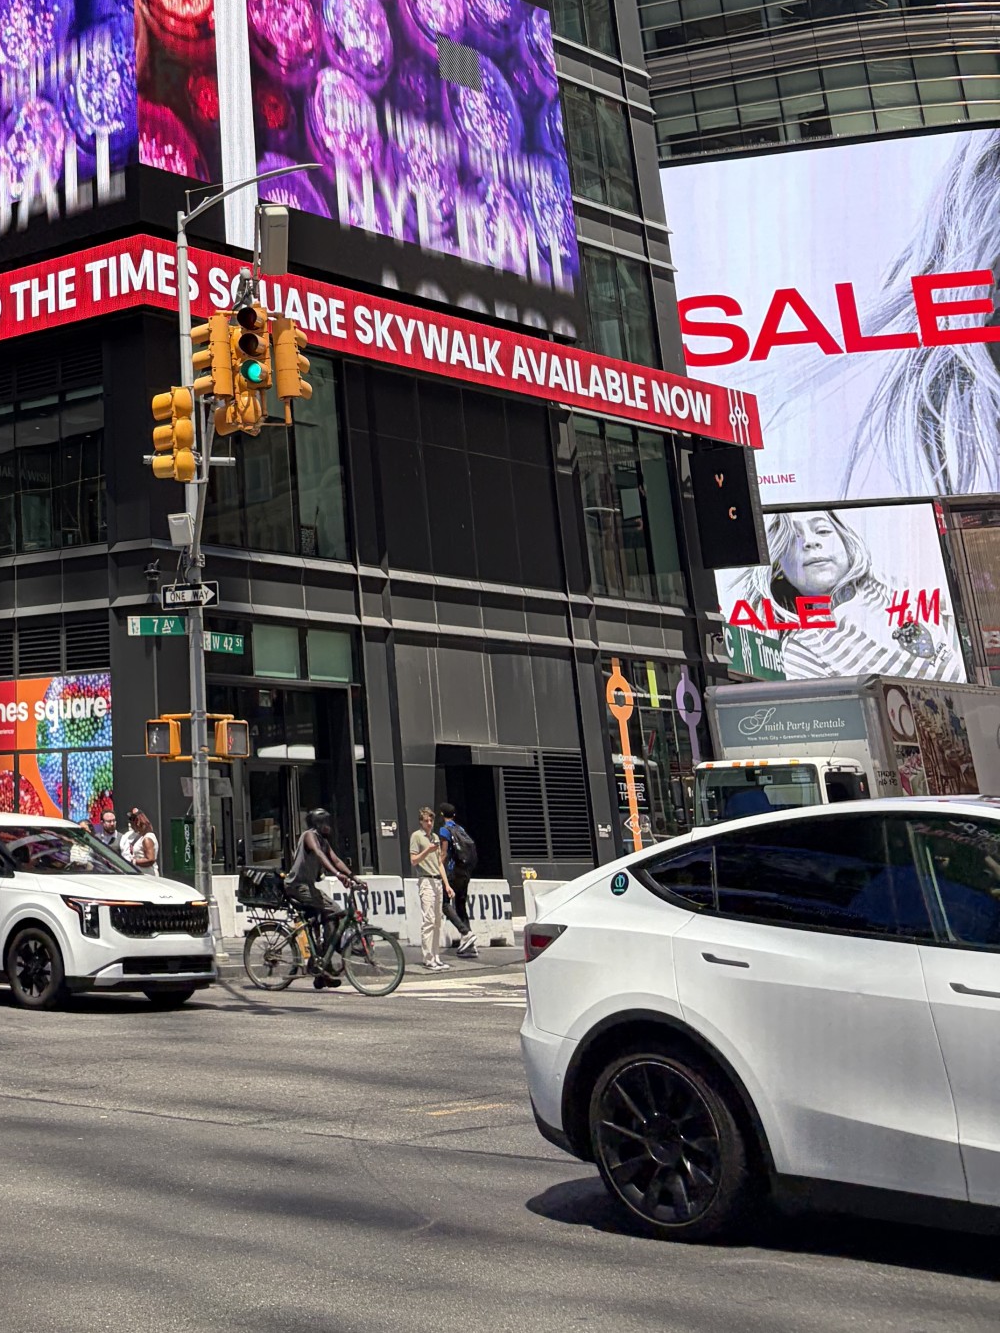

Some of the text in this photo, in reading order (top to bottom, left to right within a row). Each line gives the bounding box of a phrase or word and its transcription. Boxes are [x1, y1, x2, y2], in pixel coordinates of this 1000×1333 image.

[677, 269, 1000, 367] SALE
[9, 266, 78, 322] THE
[84, 248, 200, 303] TIMES
[354, 304, 506, 377] SKYWALK
[511, 344, 649, 412] AVAILABLE
[651, 378, 712, 426] NOW
[714, 473, 725, 488] Y
[728, 506, 738, 520] C
[169, 590, 209, 602] ONE WAY
[885, 588, 941, 628] H&M
[152, 619, 175, 633] 7 Av
[719, 594, 837, 632] ALE
[212, 635, 243, 651] W 42 St
[34, 696, 108, 733] square
[738, 707, 846, 736] Smith Party Rentals
[619, 792, 647, 802] TREL
[466, 893, 501, 920] YPD
